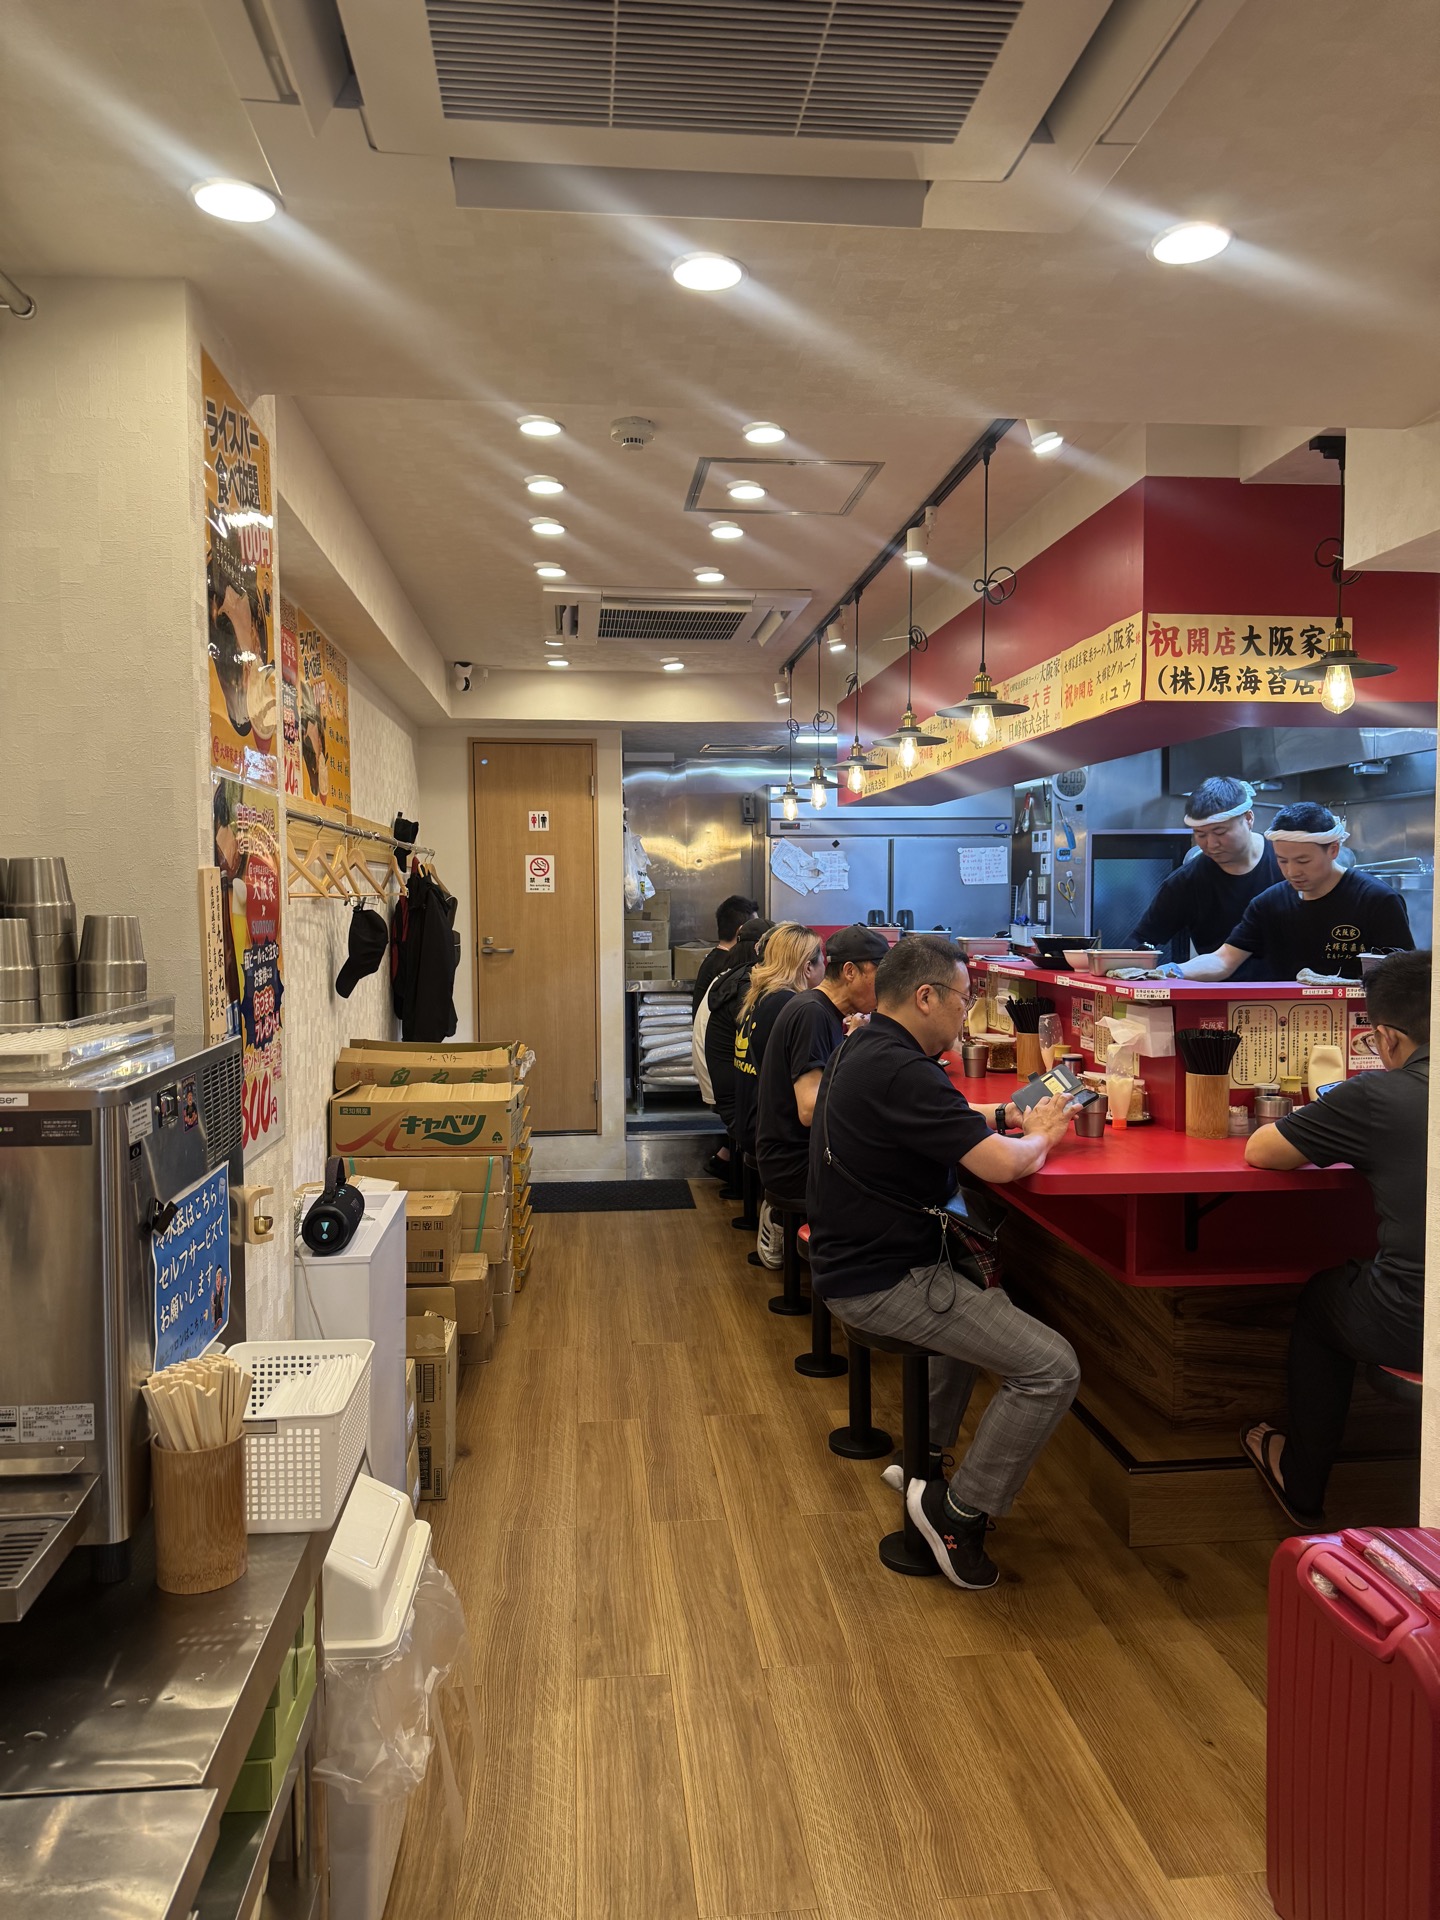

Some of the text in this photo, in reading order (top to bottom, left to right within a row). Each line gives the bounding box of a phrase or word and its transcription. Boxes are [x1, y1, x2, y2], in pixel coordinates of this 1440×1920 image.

[205, 398, 260, 460] ライスバー
[214, 451, 261, 510] 食べ放題
[237, 523, 271, 568] 100円
[1148, 620, 1327, 658] 祝開店大阪家
[252, 874, 276, 903] 大阪家
[251, 919, 276, 935] SUNTORY
[1335, 928, 1357, 938] 大阪家
[253, 988, 275, 1018] おつまみ
[1338, 988, 1343, 998] 8
[350, 1067, 376, 1082] 特選
[342, 1107, 369, 1115] 愛知県産
[400, 1114, 487, 1146] キャベツ
[158, 1210, 225, 1290] セルフサービスで
[160, 1261, 214, 1334] お願いします
